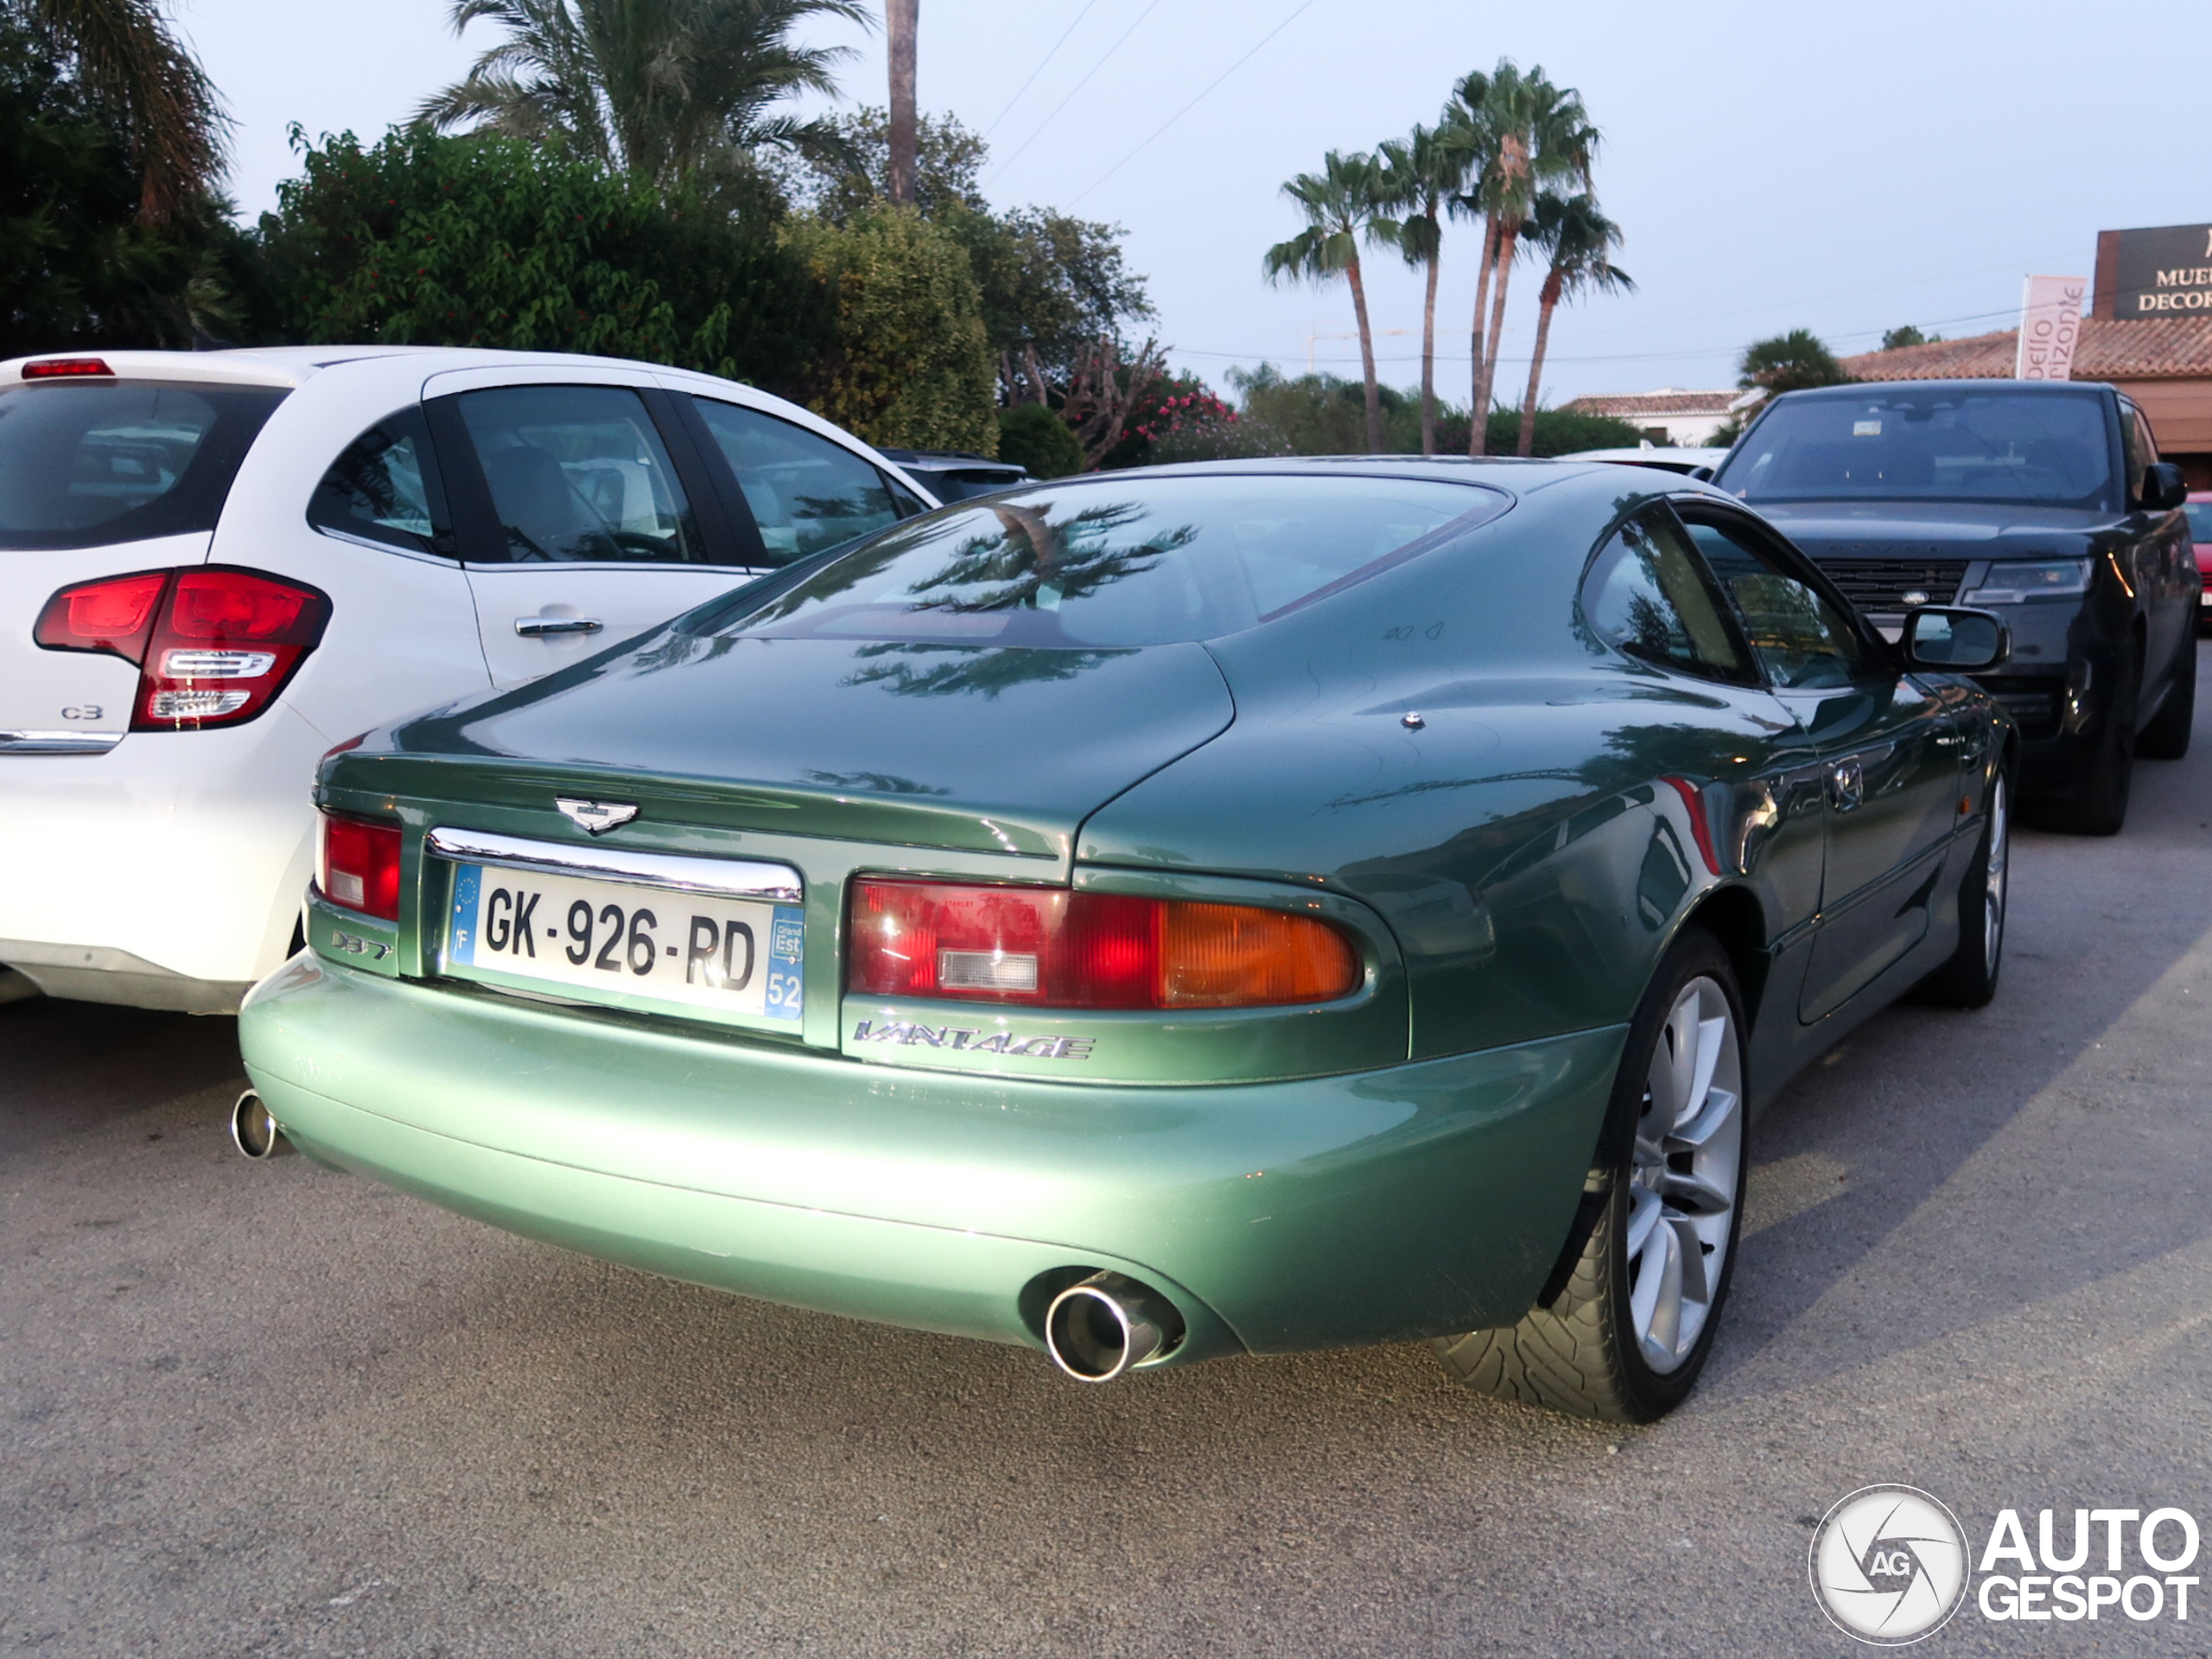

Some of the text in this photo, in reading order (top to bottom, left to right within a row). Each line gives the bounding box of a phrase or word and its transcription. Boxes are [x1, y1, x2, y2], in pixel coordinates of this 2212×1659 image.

[2156, 267, 2212, 287] MUE
[456, 929, 467, 949] F
[486, 887, 755, 992] GK-926-RD
[776, 934, 800, 952] Est
[778, 925, 802, 937] Grand
[332, 930, 394, 961] DB7
[767, 972, 801, 1008] 52
[853, 1020, 1096, 1060] VANTAGE
